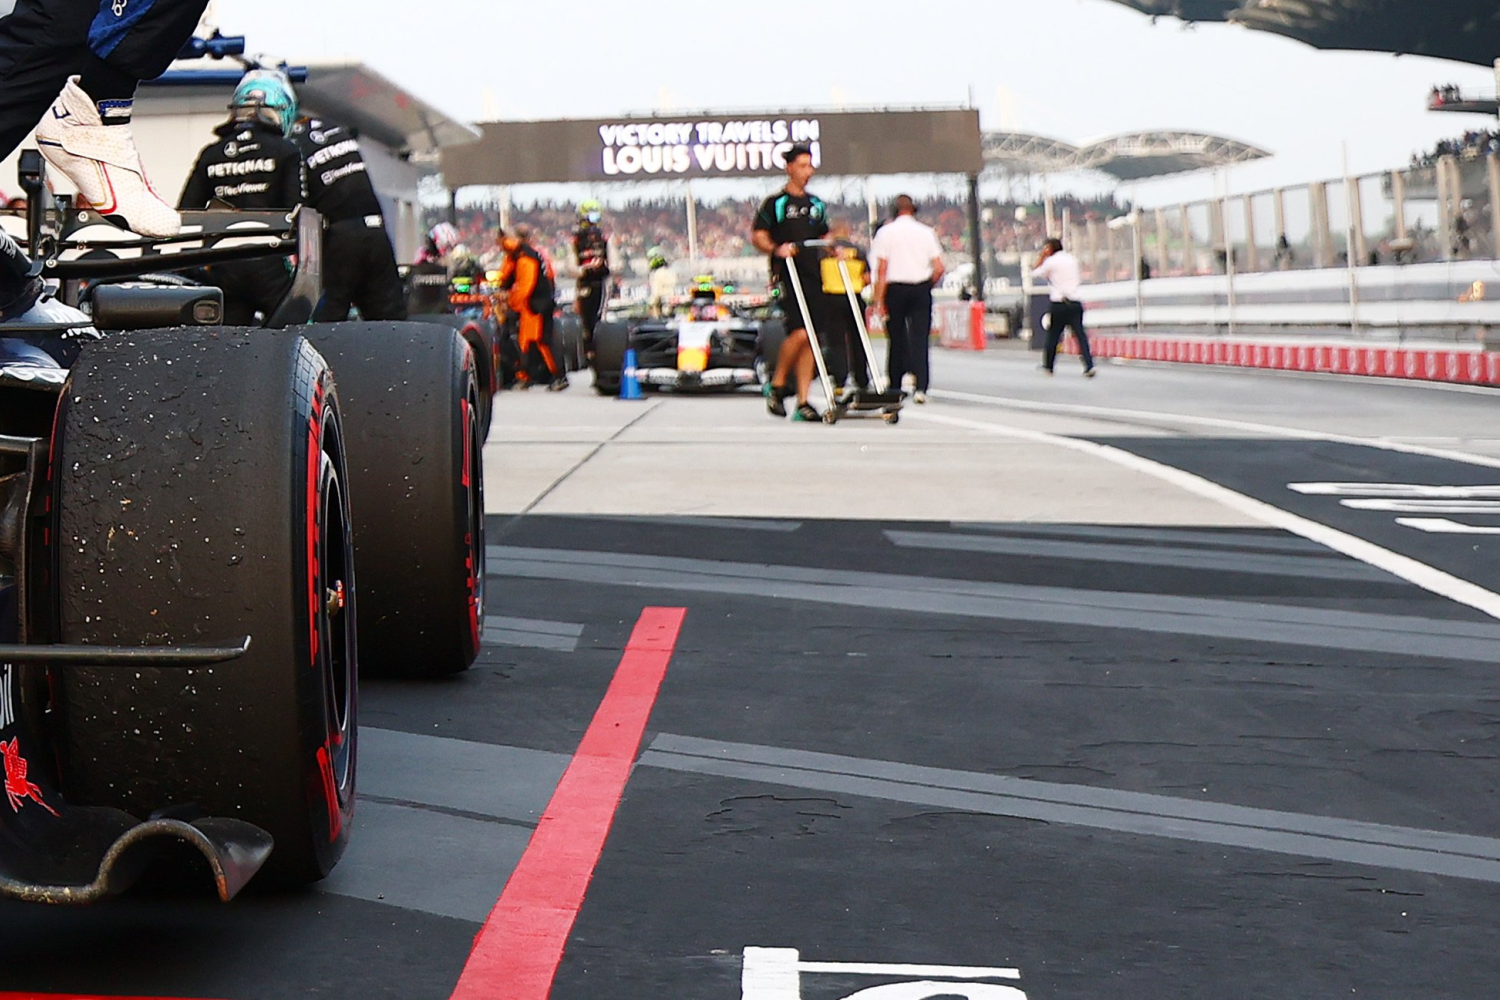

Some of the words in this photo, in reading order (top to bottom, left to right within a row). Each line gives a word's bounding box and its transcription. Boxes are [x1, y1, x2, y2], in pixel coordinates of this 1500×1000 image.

[599, 123, 693, 147] VICTORY
[695, 120, 789, 144] TRAVELS
[791, 118, 820, 142] IN
[602, 144, 691, 175] LOUIS
